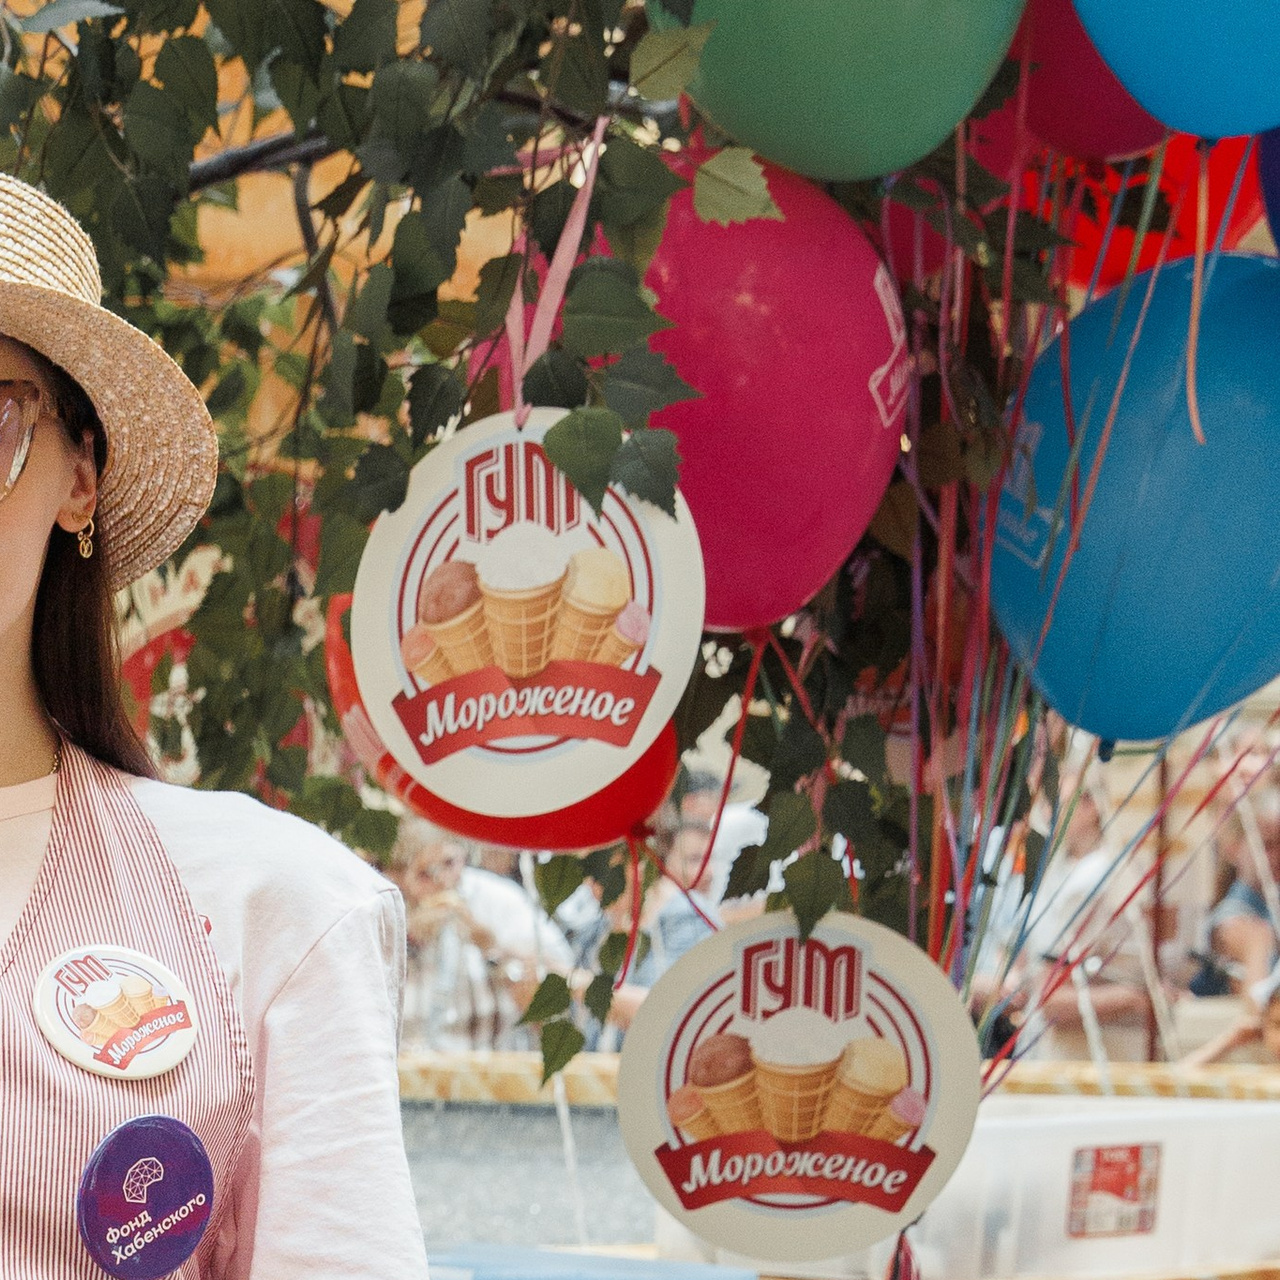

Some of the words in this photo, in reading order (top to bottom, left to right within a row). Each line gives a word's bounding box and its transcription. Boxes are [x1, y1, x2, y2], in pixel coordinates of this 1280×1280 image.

[464, 441, 581, 543] ГУМ
[420, 685, 635, 747] Мороженое
[54, 954, 112, 998] ГУМ
[741, 938, 863, 1023] ГУМ
[111, 1010, 185, 1066] Мороженое
[681, 1150, 908, 1195] Мороженое
[105, 1209, 152, 1246] Фонд
[111, 1193, 207, 1265] Хабенского
